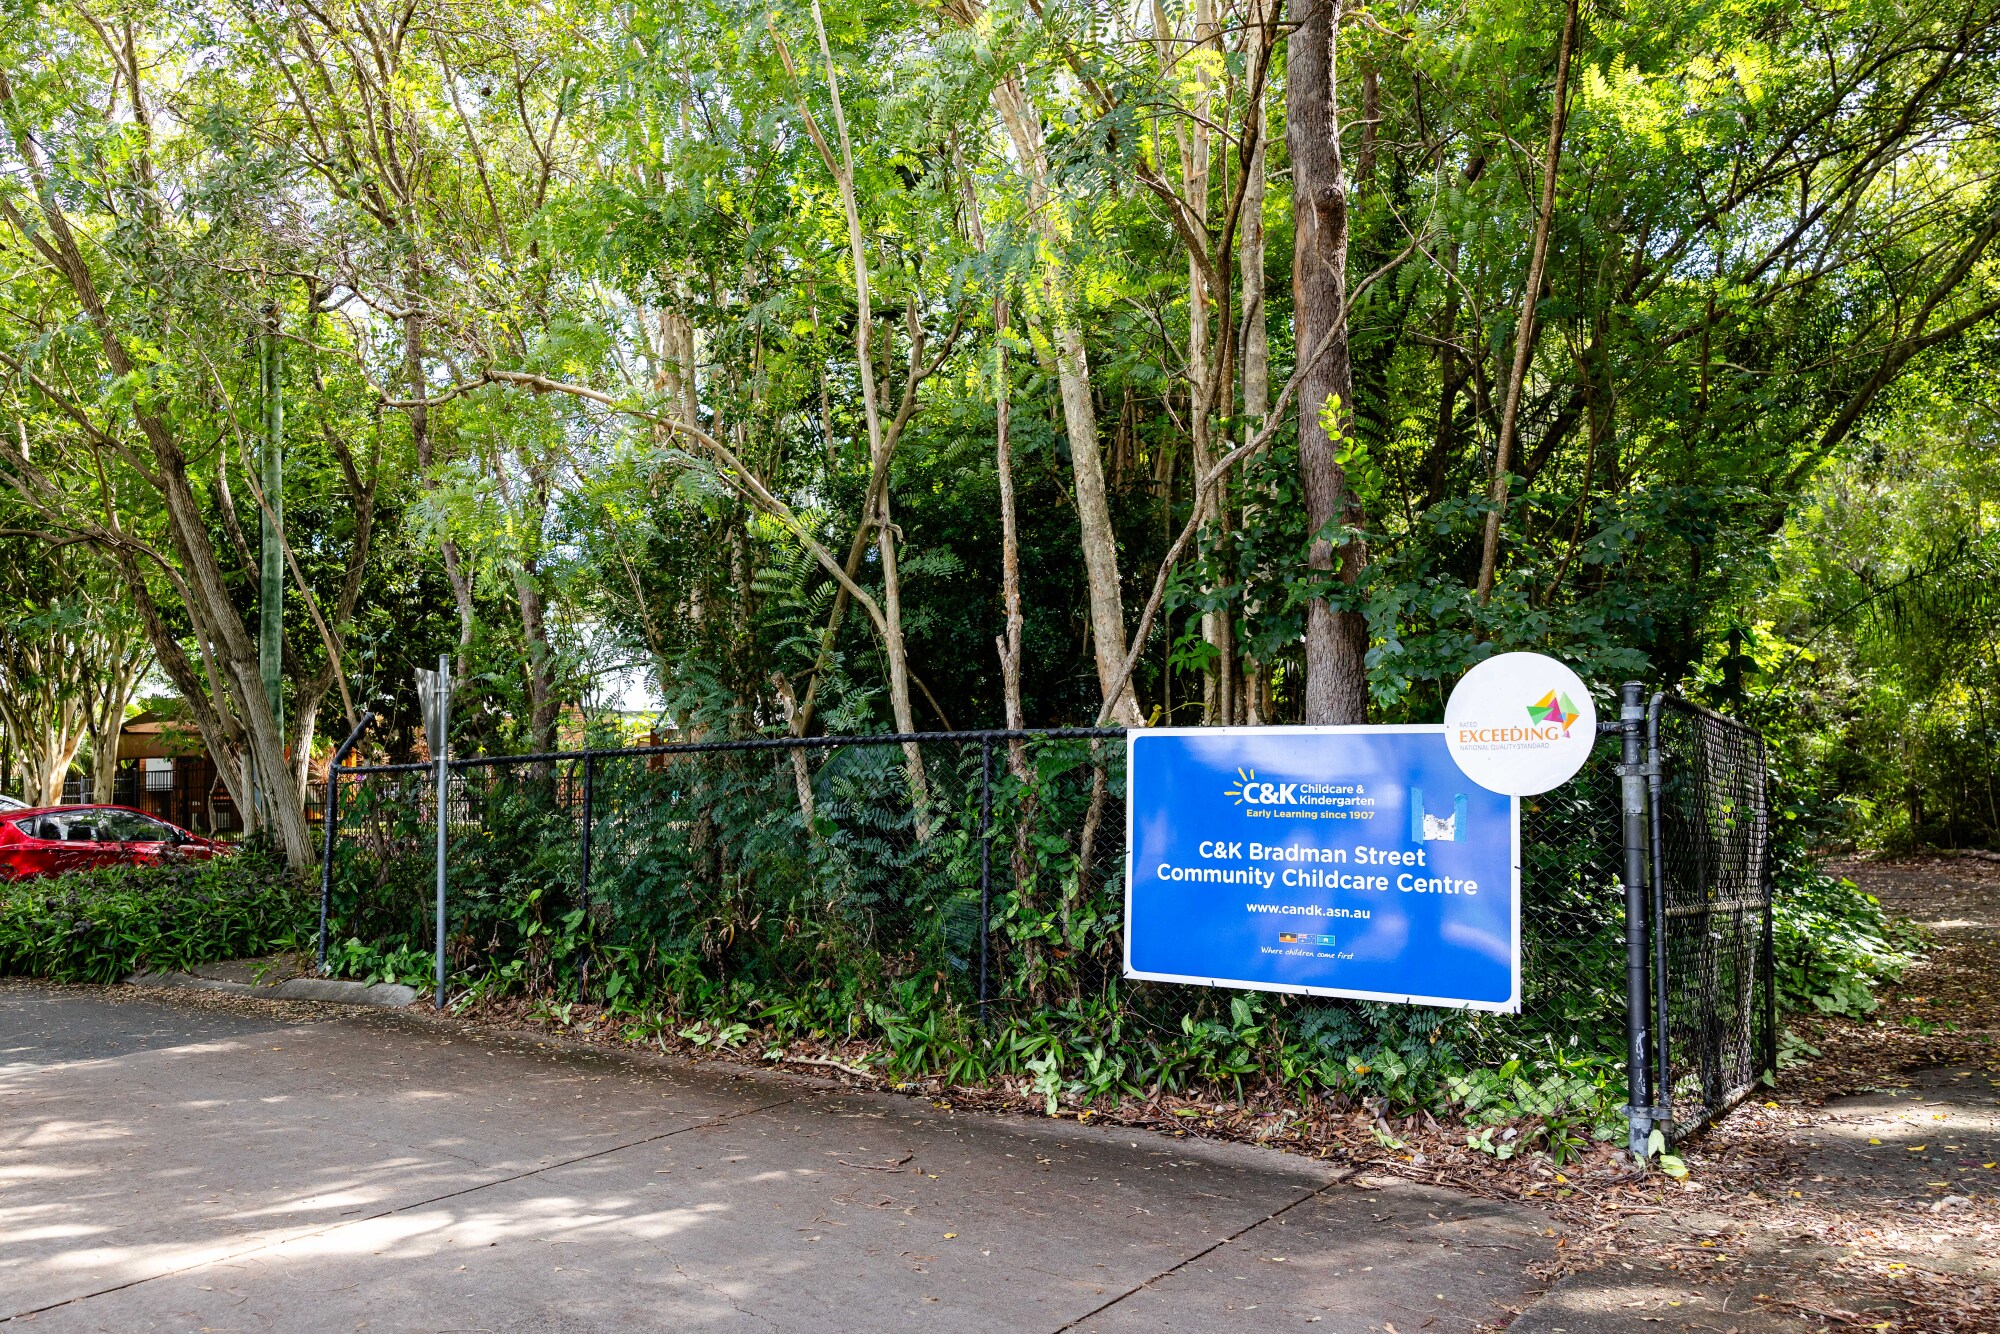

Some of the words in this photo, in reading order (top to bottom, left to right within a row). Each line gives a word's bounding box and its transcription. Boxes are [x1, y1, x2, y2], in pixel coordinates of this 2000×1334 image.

[1459, 726, 1559, 743] EXCEEDING
[1490, 743, 1516, 751] QUALITY
[1517, 742, 1550, 750] STANDARD
[1243, 782, 1298, 805] C&K
[1300, 783, 1354, 795] Childcare
[1356, 784, 1364, 795] &
[1300, 795, 1375, 807] Kindergarten
[1246, 808, 1271, 820] Early
[1273, 809, 1318, 821] Learning
[1320, 809, 1347, 820] since
[1349, 810, 1375, 820] 1907
[1199, 841, 1242, 860] C&K
[1249, 842, 1347, 864] Bradman
[1354, 846, 1426, 867] Street
[1157, 864, 1275, 889] Community
[1282, 868, 1389, 891] Childcare
[1396, 874, 1478, 895] Centre
[1246, 902, 1371, 919] www.candk.asn.au
[1261, 946, 1283, 955] Where
[1285, 948, 1314, 957] children
[1337, 951, 1354, 960] first
